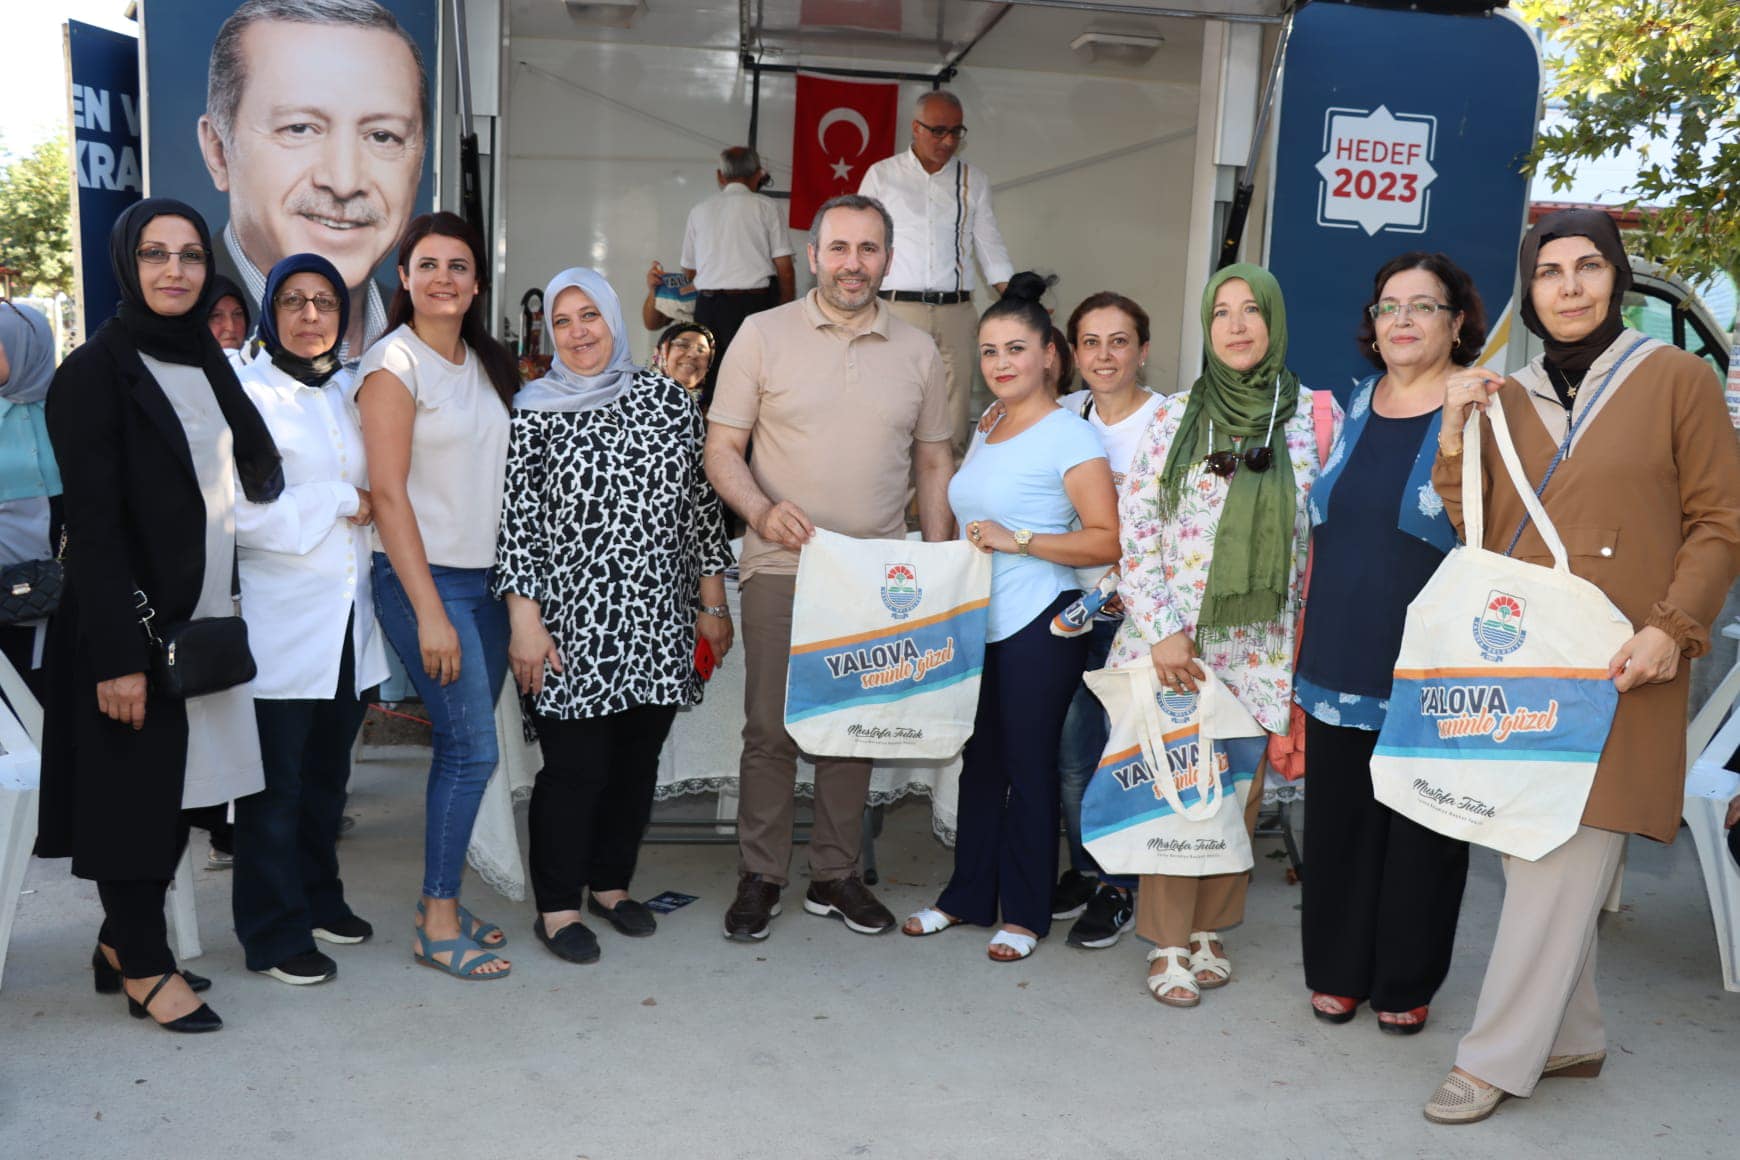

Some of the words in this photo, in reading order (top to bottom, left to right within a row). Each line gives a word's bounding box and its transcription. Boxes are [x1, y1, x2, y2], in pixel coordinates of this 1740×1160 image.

[1336, 138, 1421, 165] HEDEF
[1332, 168, 1418, 203] 2023
[824, 638, 920, 678] YALOVA
[861, 657, 913, 688] seninle
[913, 637, 954, 681] güzel
[1421, 686, 1508, 715] YALOVA
[1493, 699, 1559, 743] güzel
[1413, 778, 1456, 805] Mustafa
